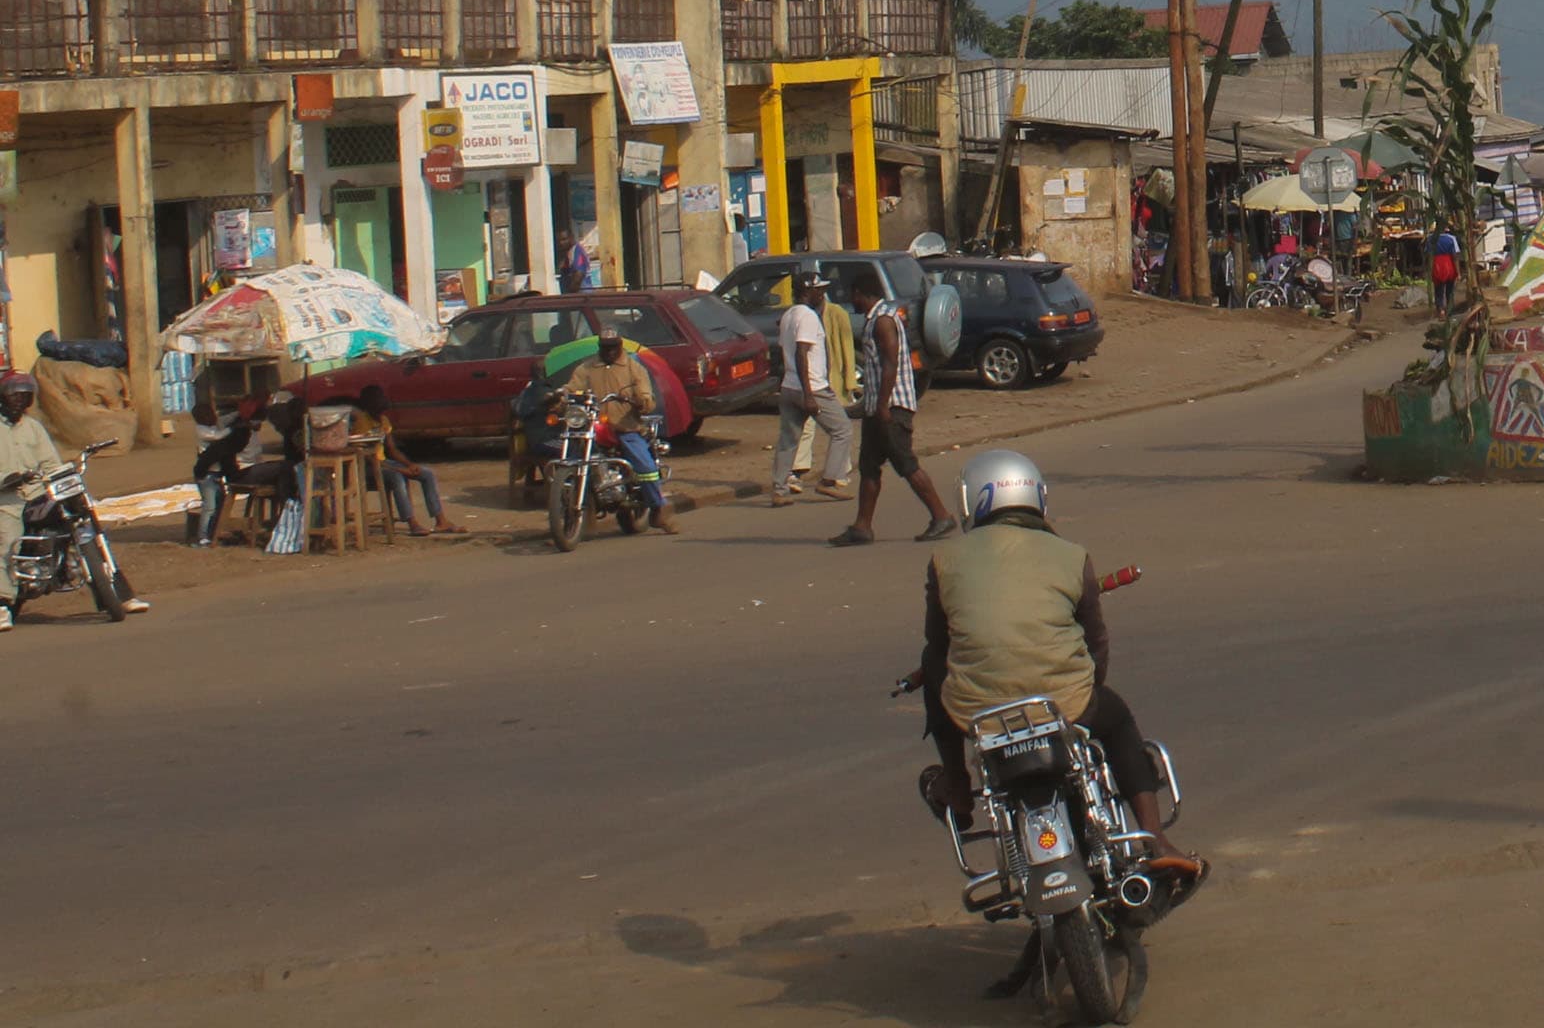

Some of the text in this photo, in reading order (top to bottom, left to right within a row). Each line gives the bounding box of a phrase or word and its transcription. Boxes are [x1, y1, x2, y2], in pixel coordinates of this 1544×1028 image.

[465, 82, 528, 102] JACO
[508, 135, 528, 146] Sarl
[1003, 736, 1050, 758] NANFAN
